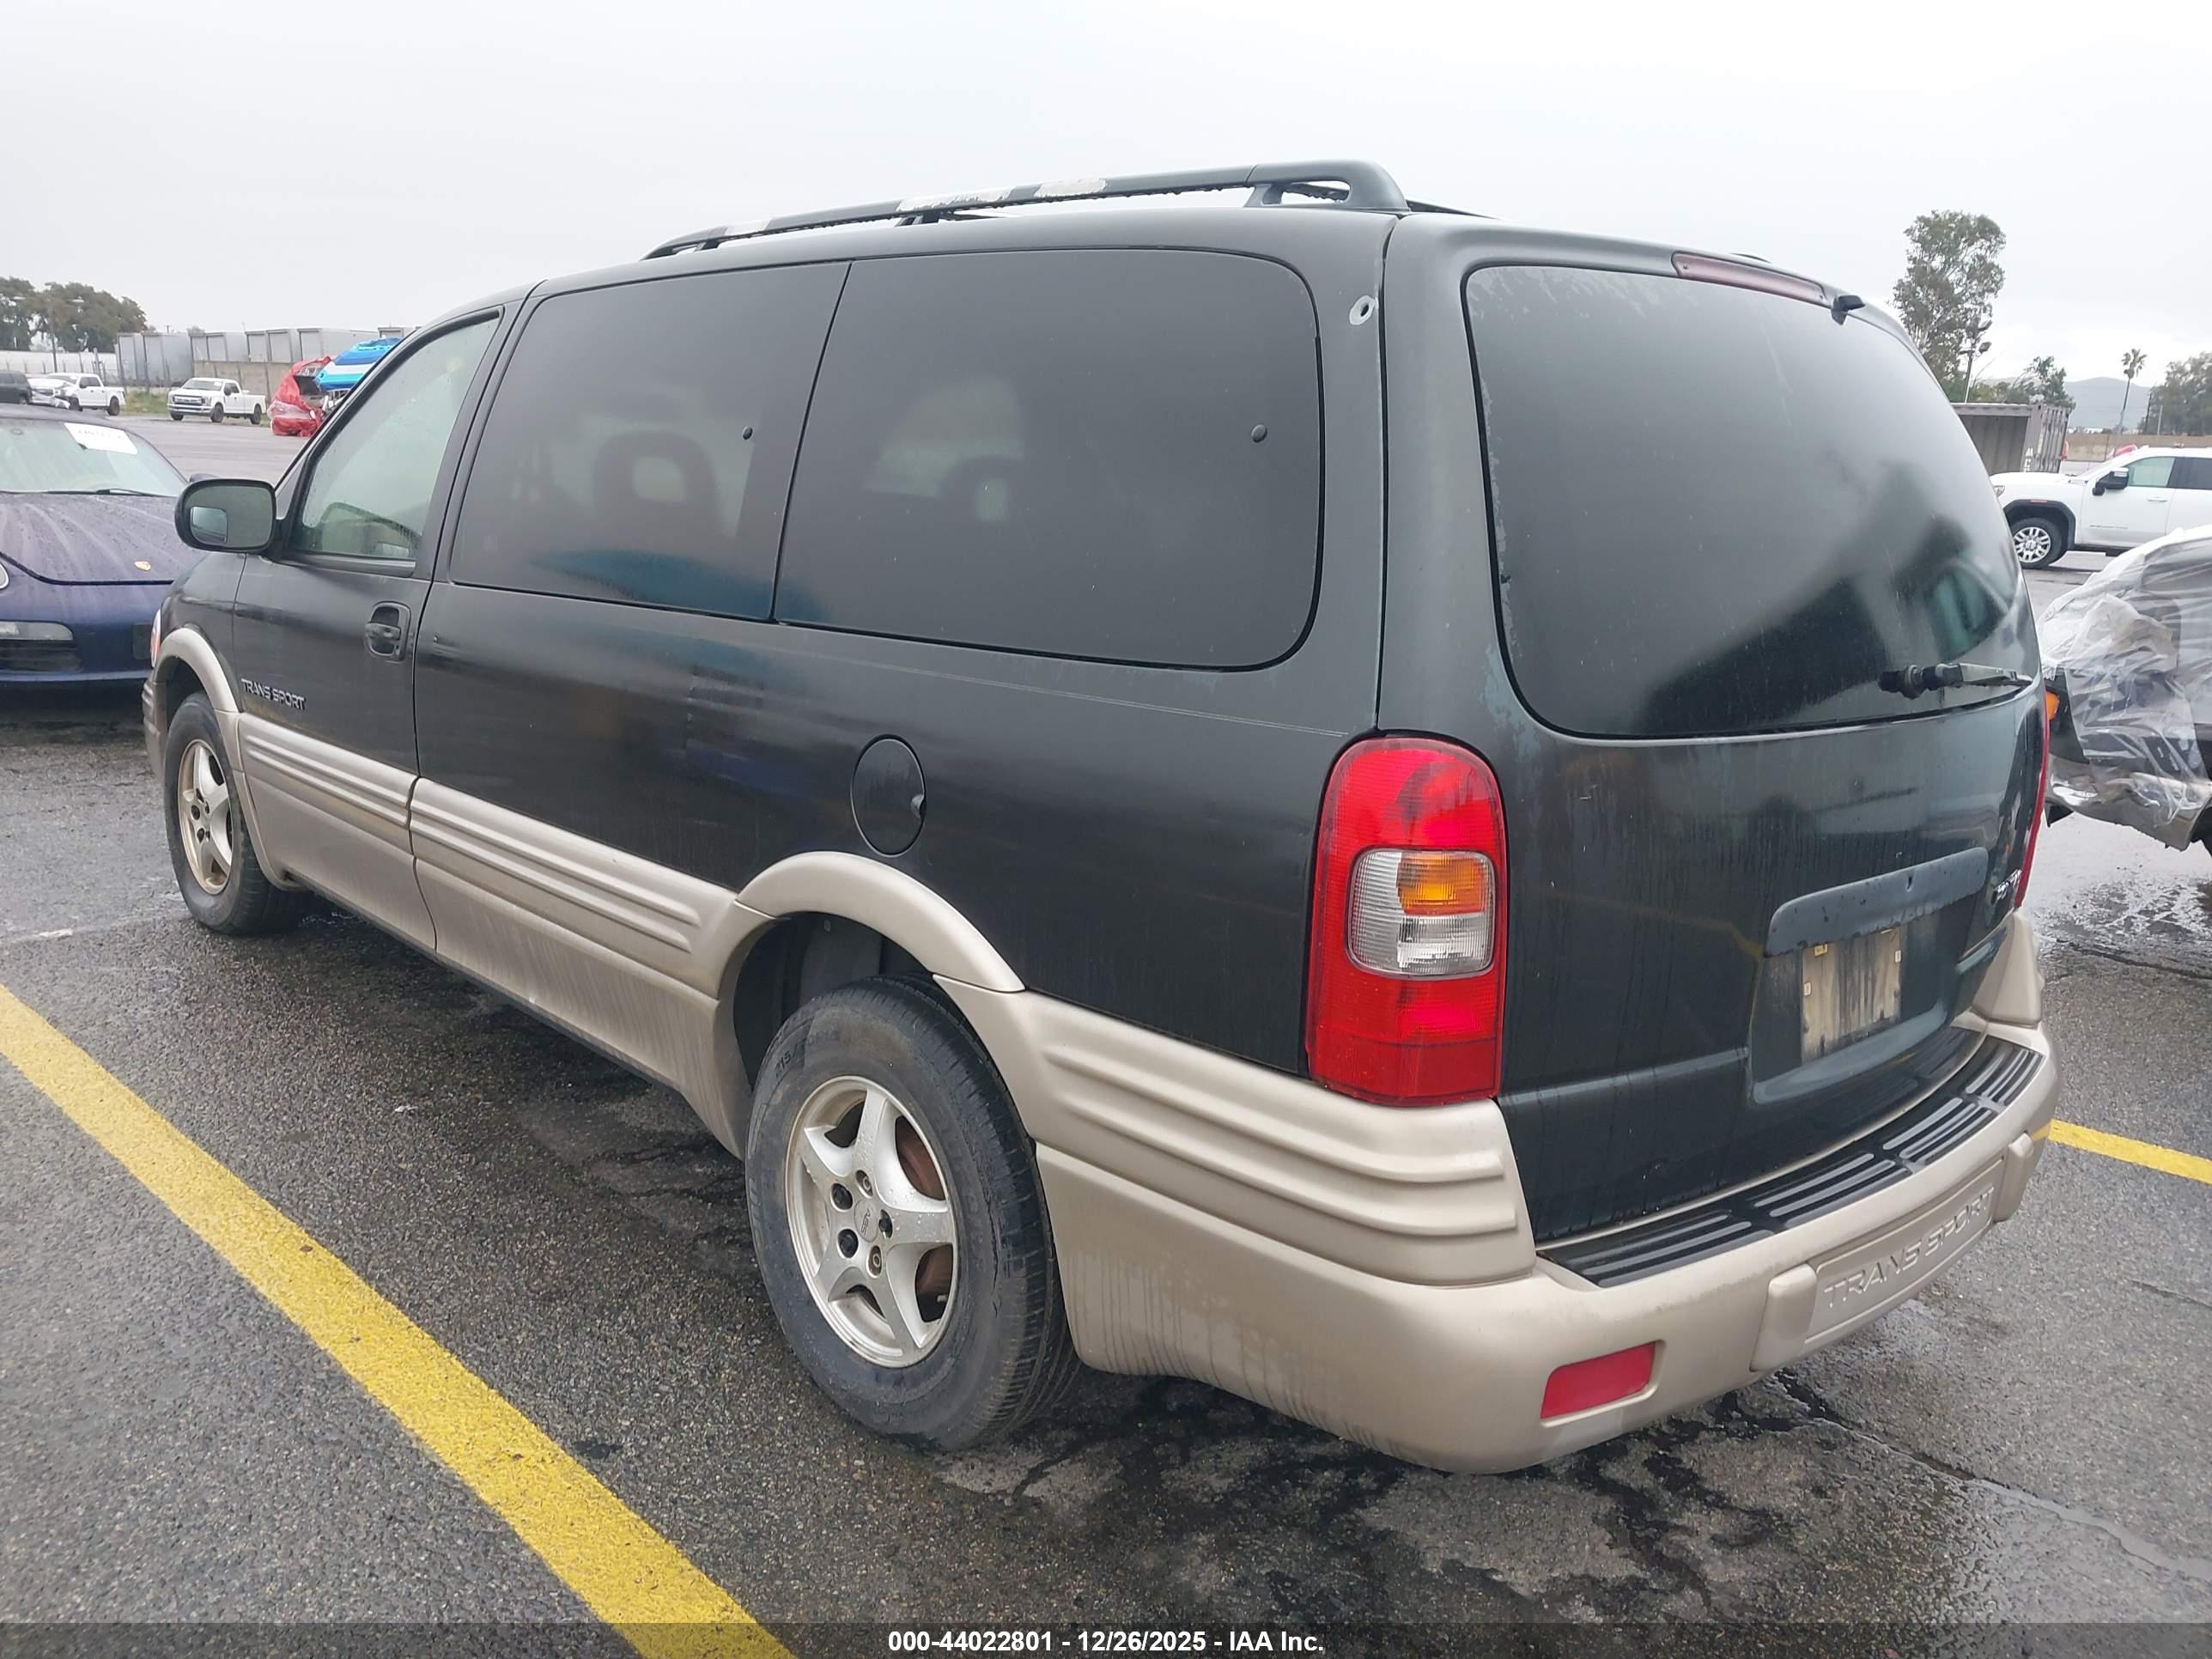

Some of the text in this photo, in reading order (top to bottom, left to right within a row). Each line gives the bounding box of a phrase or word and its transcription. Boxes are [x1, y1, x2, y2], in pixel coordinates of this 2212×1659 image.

[240, 678, 306, 711] TRANS SPORT
[1823, 1186, 1995, 1308] TRANS SPORT
